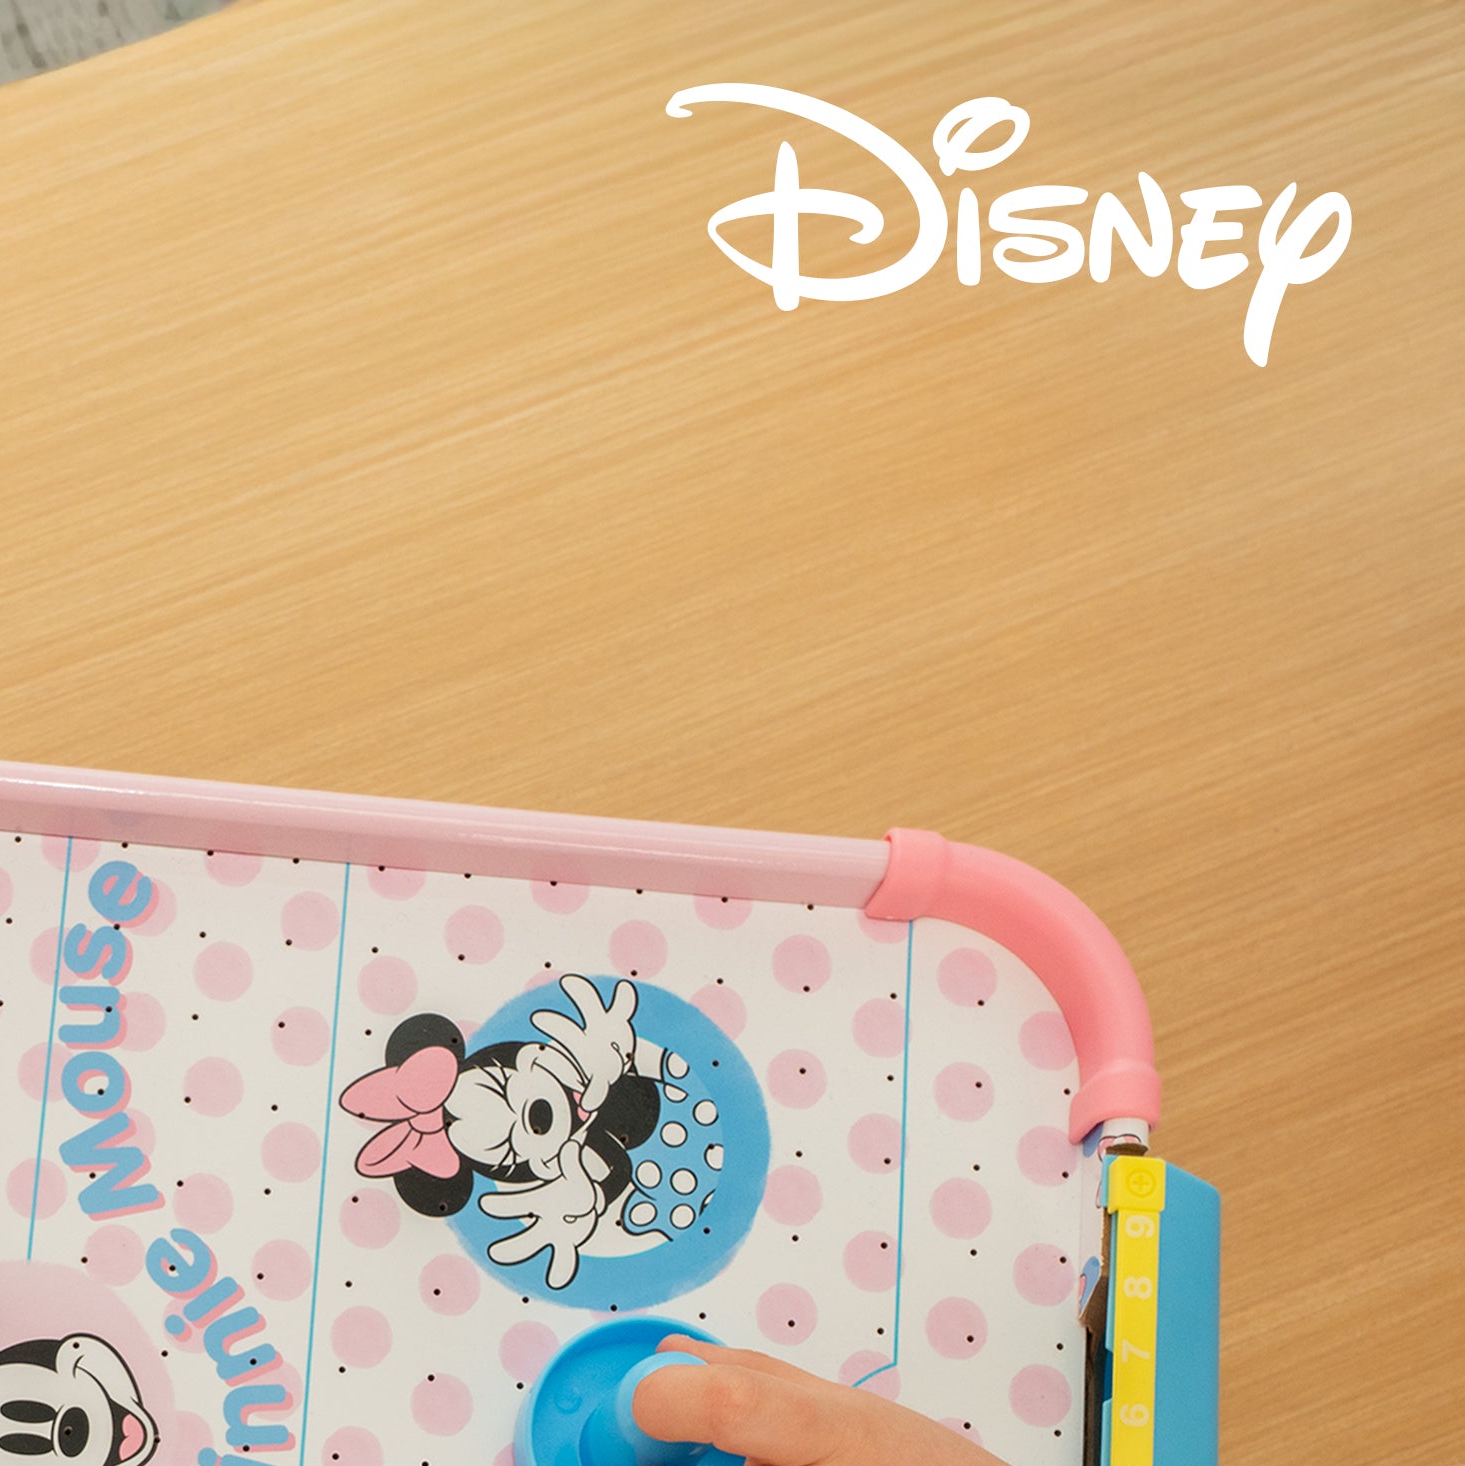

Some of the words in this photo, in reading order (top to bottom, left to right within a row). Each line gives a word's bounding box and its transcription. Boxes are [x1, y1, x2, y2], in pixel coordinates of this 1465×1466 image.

[58, 860, 165, 1220] Mouse
[1125, 1215, 1155, 1238] 9
[1123, 1276, 1154, 1300] 8
[1122, 1340, 1151, 1363] 7
[1119, 1404, 1149, 1427] 6
